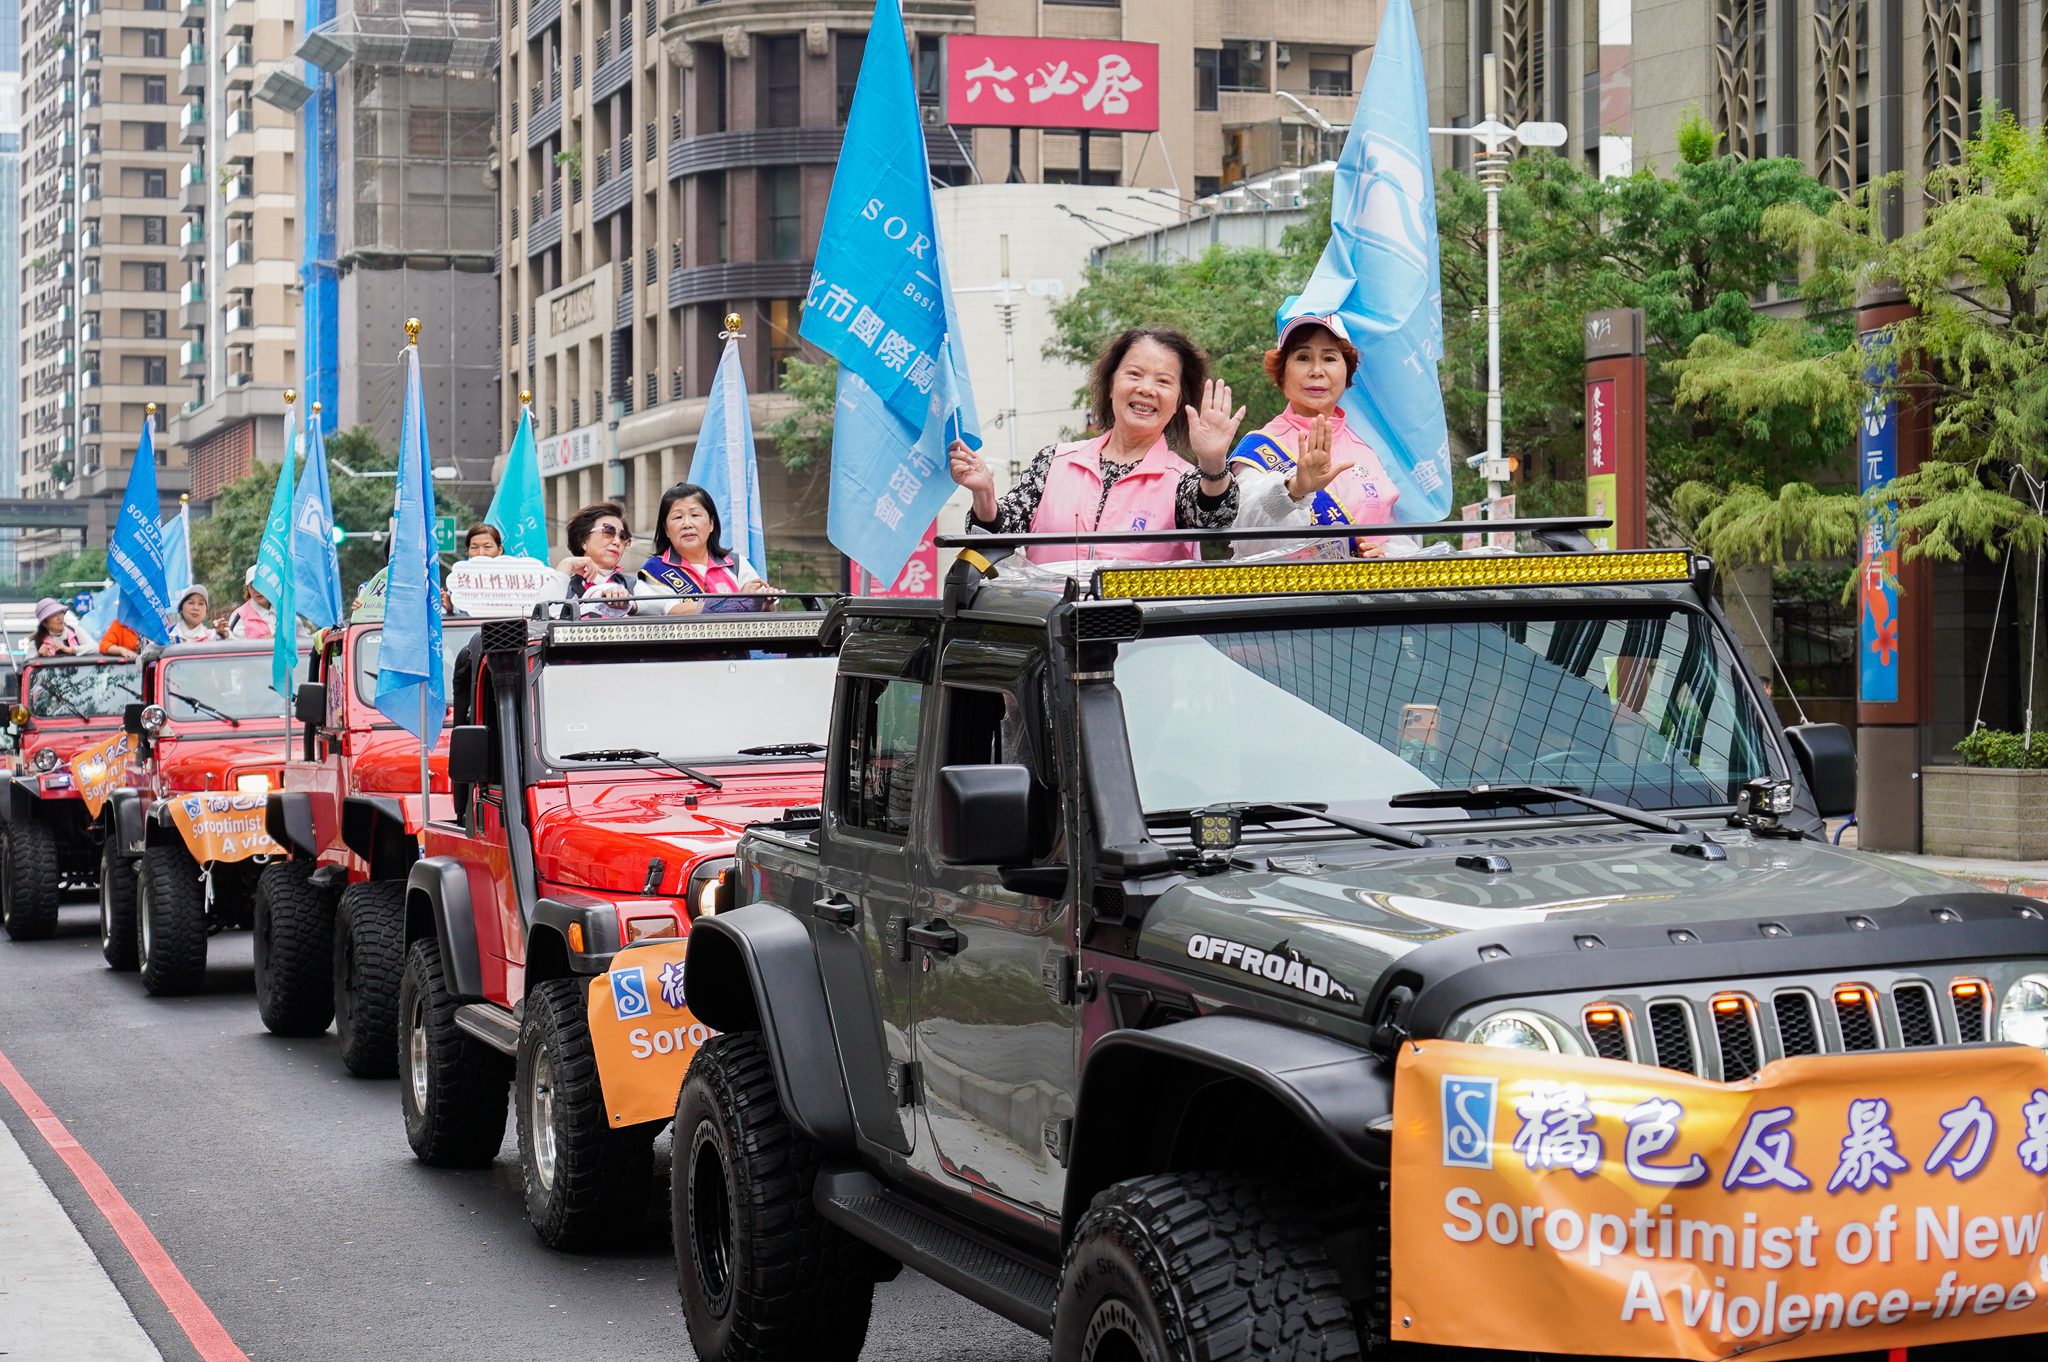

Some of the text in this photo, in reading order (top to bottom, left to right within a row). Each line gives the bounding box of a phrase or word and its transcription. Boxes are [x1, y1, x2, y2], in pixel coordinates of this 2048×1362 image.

[965, 54, 1143, 115] 六必居
[861, 198, 938, 274] SOR
[903, 282, 936, 312] Best
[222, 837, 237, 853] A
[1187, 934, 1329, 998] OFFROAD
[1442, 1187, 2045, 1269] Soroptimist of New
[1620, 1270, 2037, 1338] A violence-free
